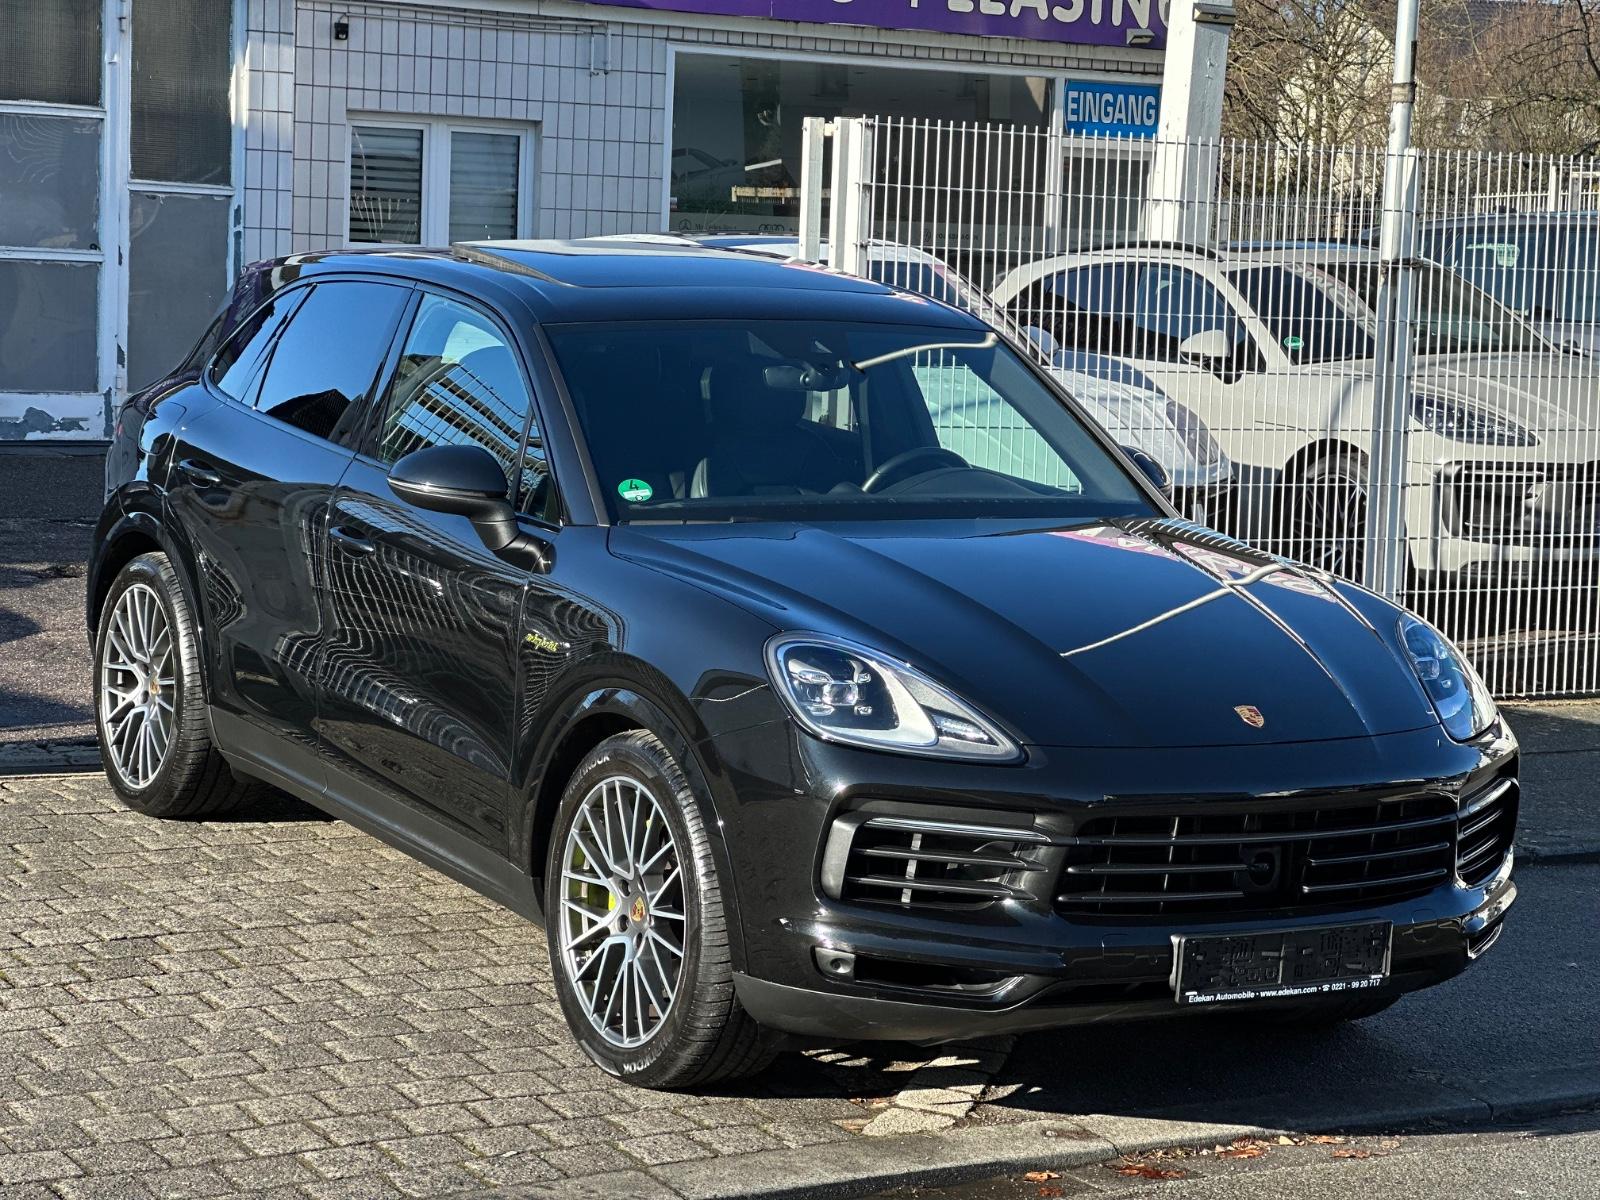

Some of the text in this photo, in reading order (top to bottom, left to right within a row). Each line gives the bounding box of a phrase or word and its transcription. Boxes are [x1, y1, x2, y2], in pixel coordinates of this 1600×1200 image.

[1067, 91, 1156, 126] EINGANG
[1188, 995, 1214, 1003] Edekan
[1215, 990, 1255, 1001] Automobile
[1260, 987, 1318, 998] www.edekan.com
[1331, 983, 1346, 991] 0221
[1351, 981, 1360, 989] 99
[1360, 980, 1368, 988] 20
[1369, 979, 1381, 987] 717
